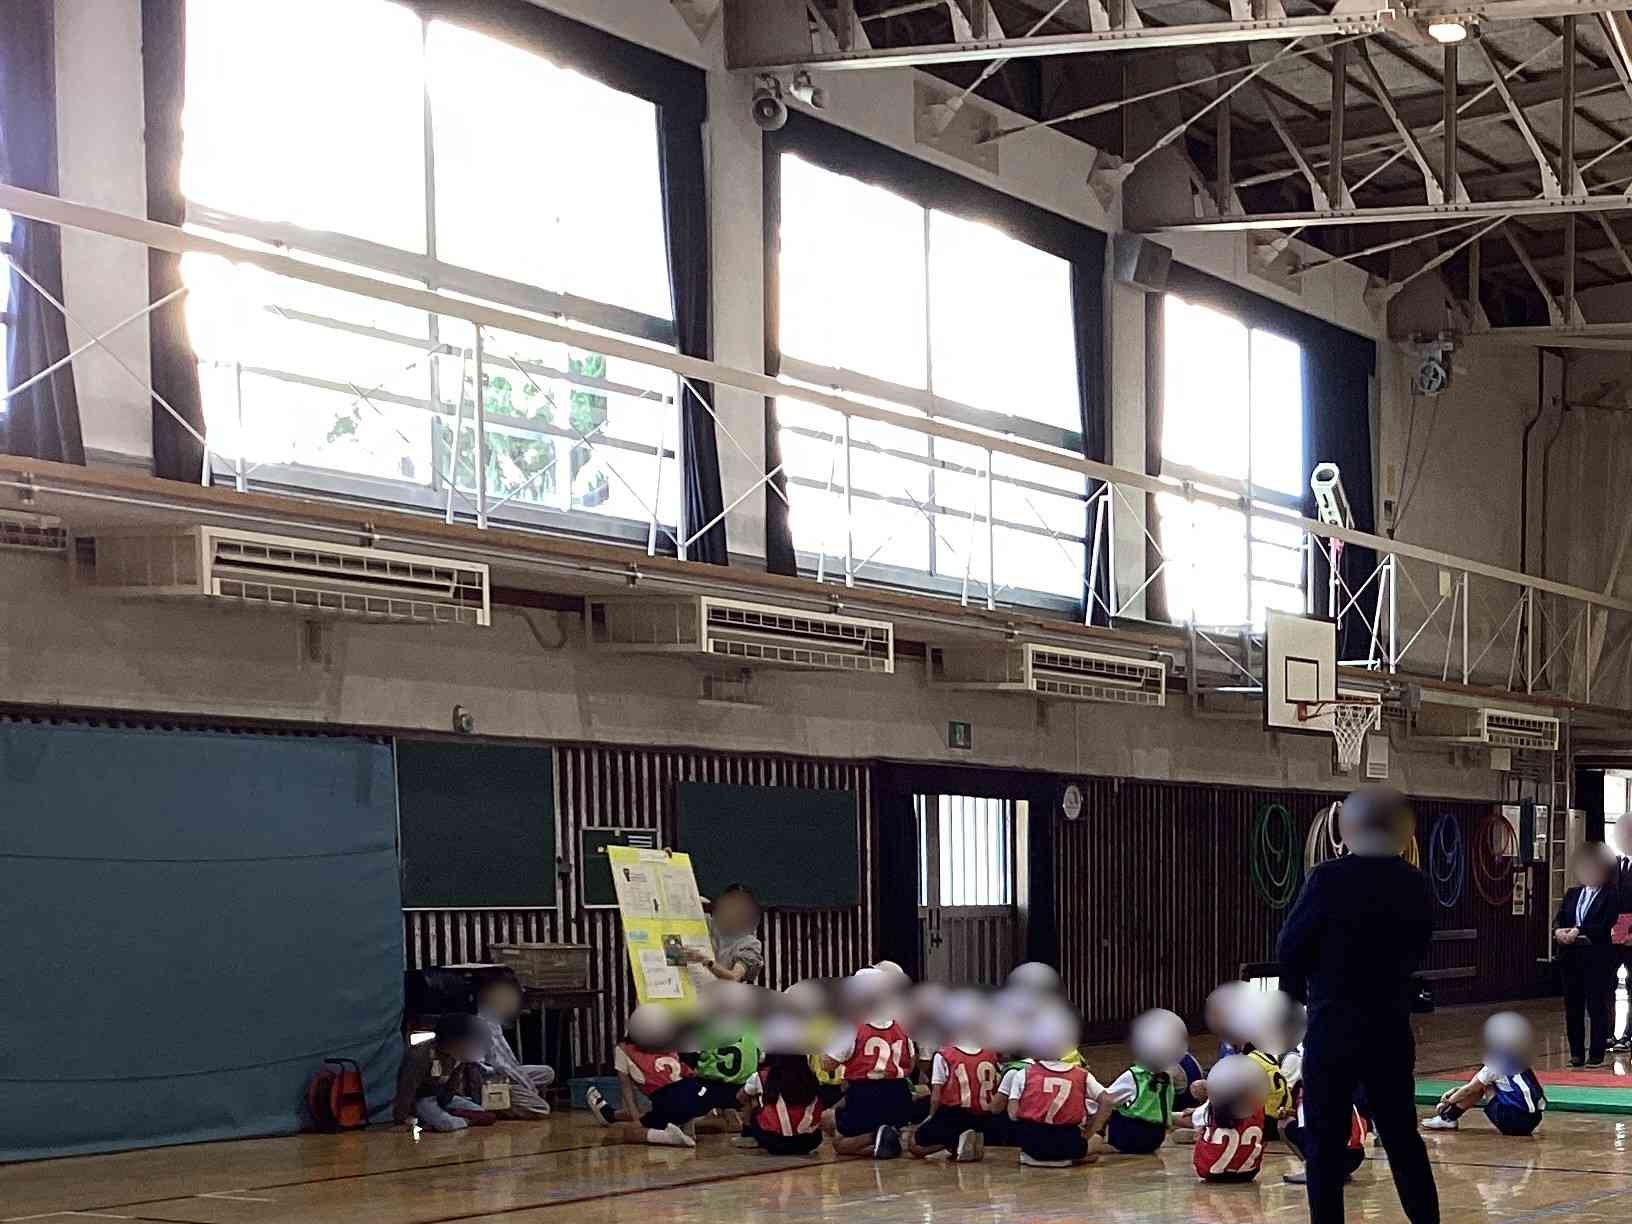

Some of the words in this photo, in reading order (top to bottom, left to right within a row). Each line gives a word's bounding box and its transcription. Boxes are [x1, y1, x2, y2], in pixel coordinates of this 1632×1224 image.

[864, 1036, 905, 1079] 21
[955, 1061, 997, 1112] 18
[1043, 1076, 1073, 1124] 7
[1210, 1125, 1263, 1175] 22
